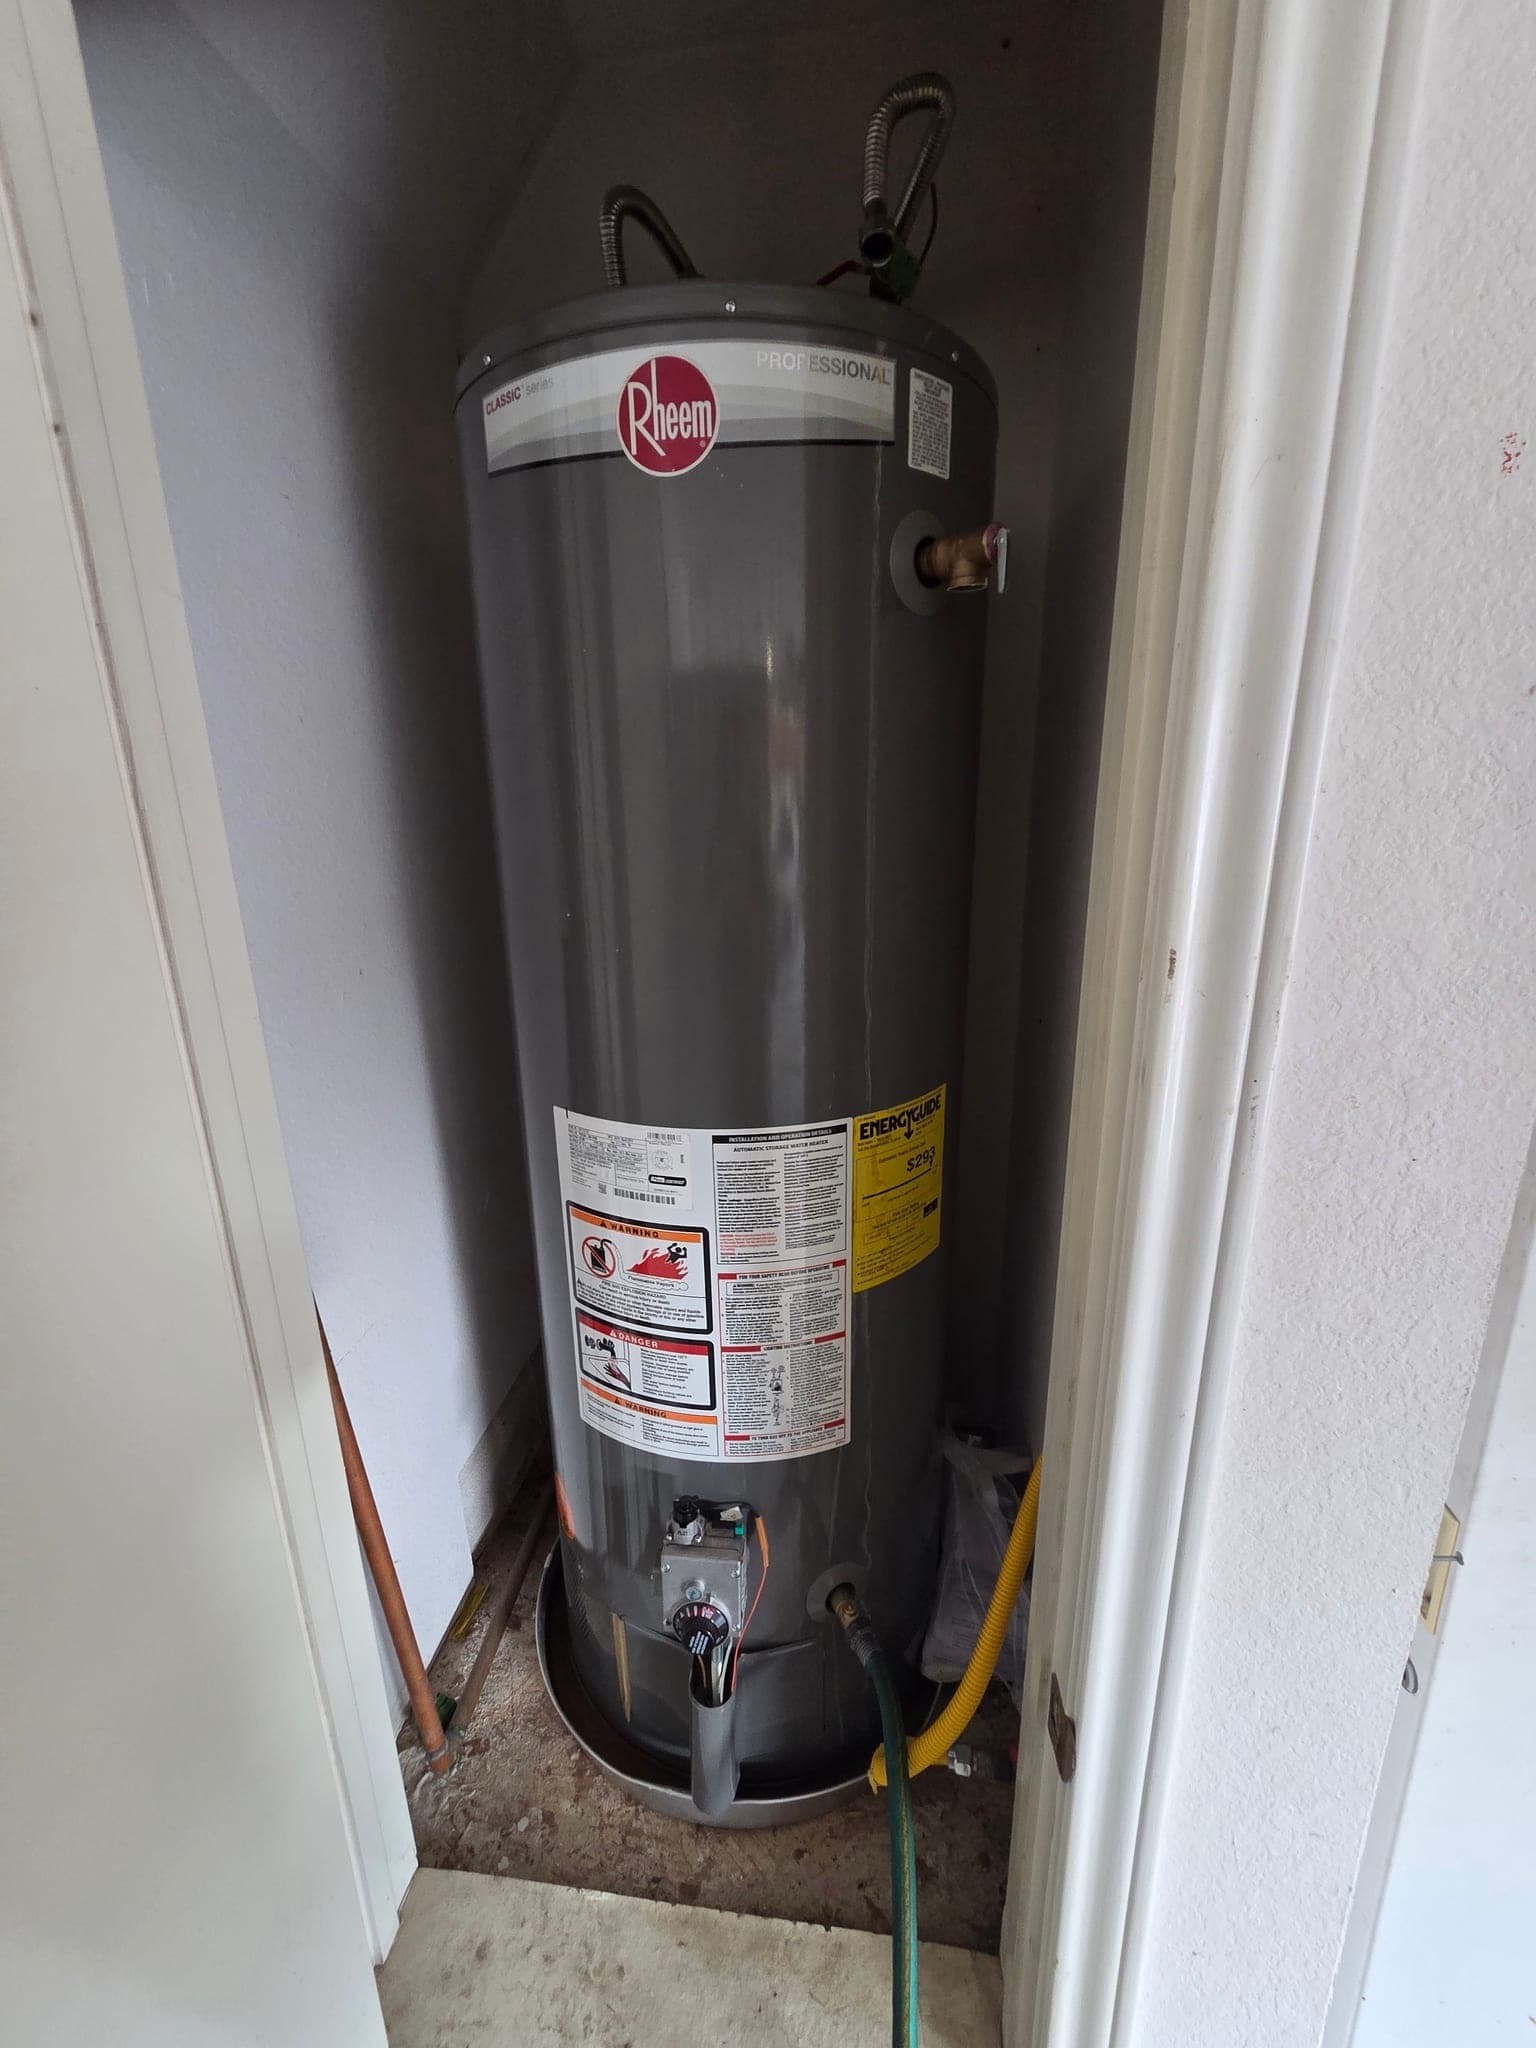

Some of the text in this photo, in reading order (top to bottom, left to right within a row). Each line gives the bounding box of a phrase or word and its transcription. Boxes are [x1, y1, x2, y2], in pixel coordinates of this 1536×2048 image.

[756, 350, 891, 385] PROFESSIONAL
[485, 377, 554, 416] CLASSIC series
[626, 359, 713, 457] Rheem
[859, 1094, 942, 1141] ENERGYGUIDE
[611, 1222, 660, 1239] WARNING
[618, 1331, 659, 1349] DANGER
[624, 1399, 668, 1418] WARNING
